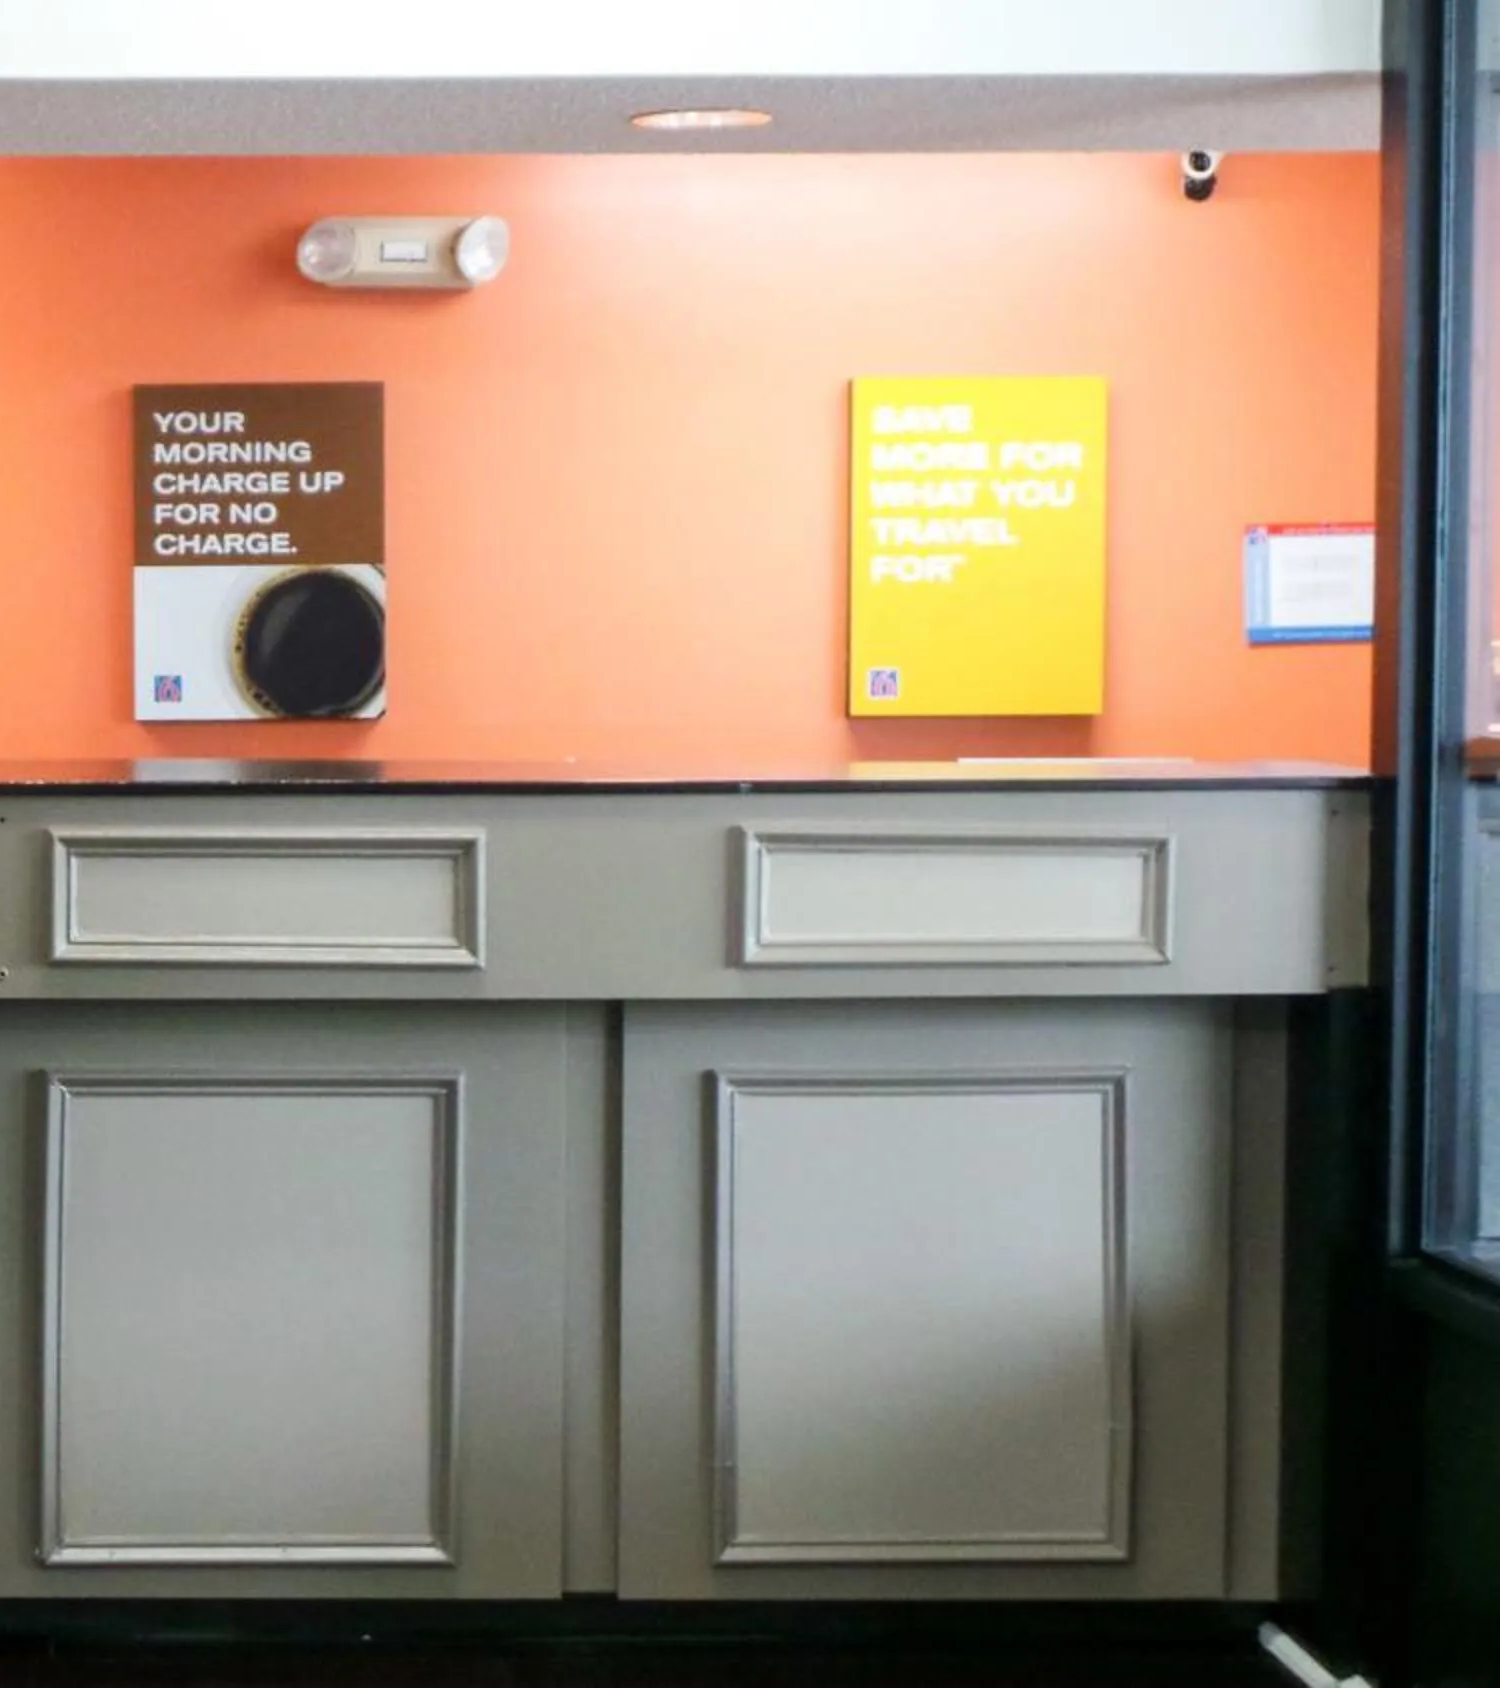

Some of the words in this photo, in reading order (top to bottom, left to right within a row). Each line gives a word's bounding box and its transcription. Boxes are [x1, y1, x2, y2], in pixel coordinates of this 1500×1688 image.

[154, 412, 245, 433] YOUR
[154, 442, 312, 464] MORNING
[871, 441, 990, 471] MORE
[999, 441, 1083, 471] FOR
[154, 473, 290, 494] CHARGE
[297, 471, 345, 493] UP
[870, 479, 978, 508] WHAT
[990, 478, 1076, 508] YOU
[154, 503, 220, 524] FOR
[229, 503, 278, 524] NO
[870, 516, 1018, 546] TRAVEL
[154, 533, 298, 555] CHARGE.
